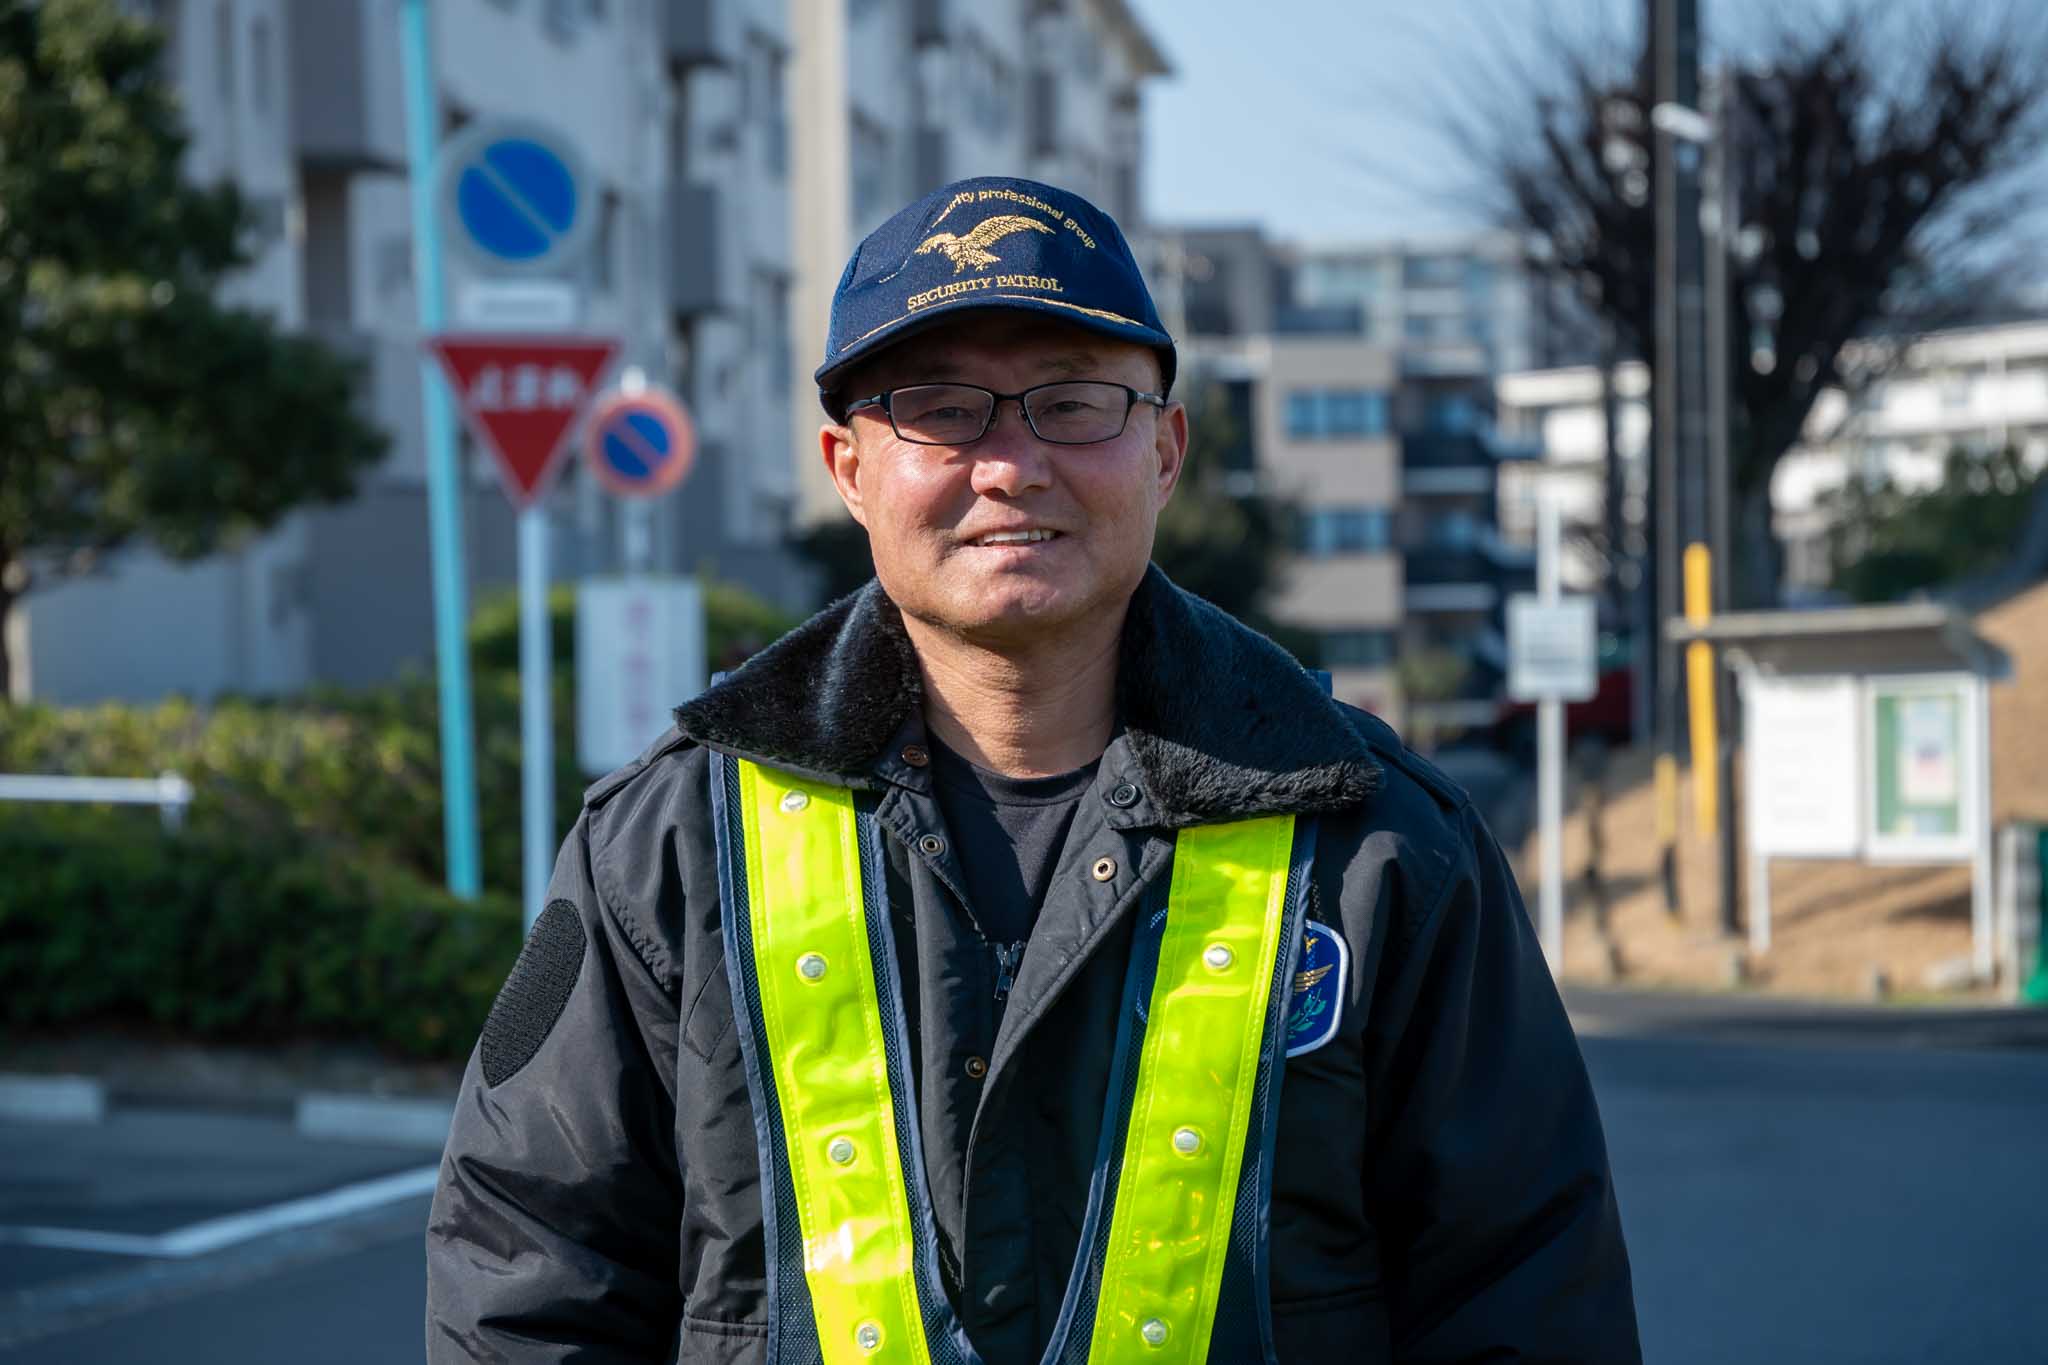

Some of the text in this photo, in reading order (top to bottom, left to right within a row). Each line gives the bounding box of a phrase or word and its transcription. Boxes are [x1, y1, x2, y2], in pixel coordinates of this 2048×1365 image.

[978, 189, 1064, 220] professional
[1063, 217, 1096, 249] group
[907, 274, 1063, 310] SECURITY PATROL
